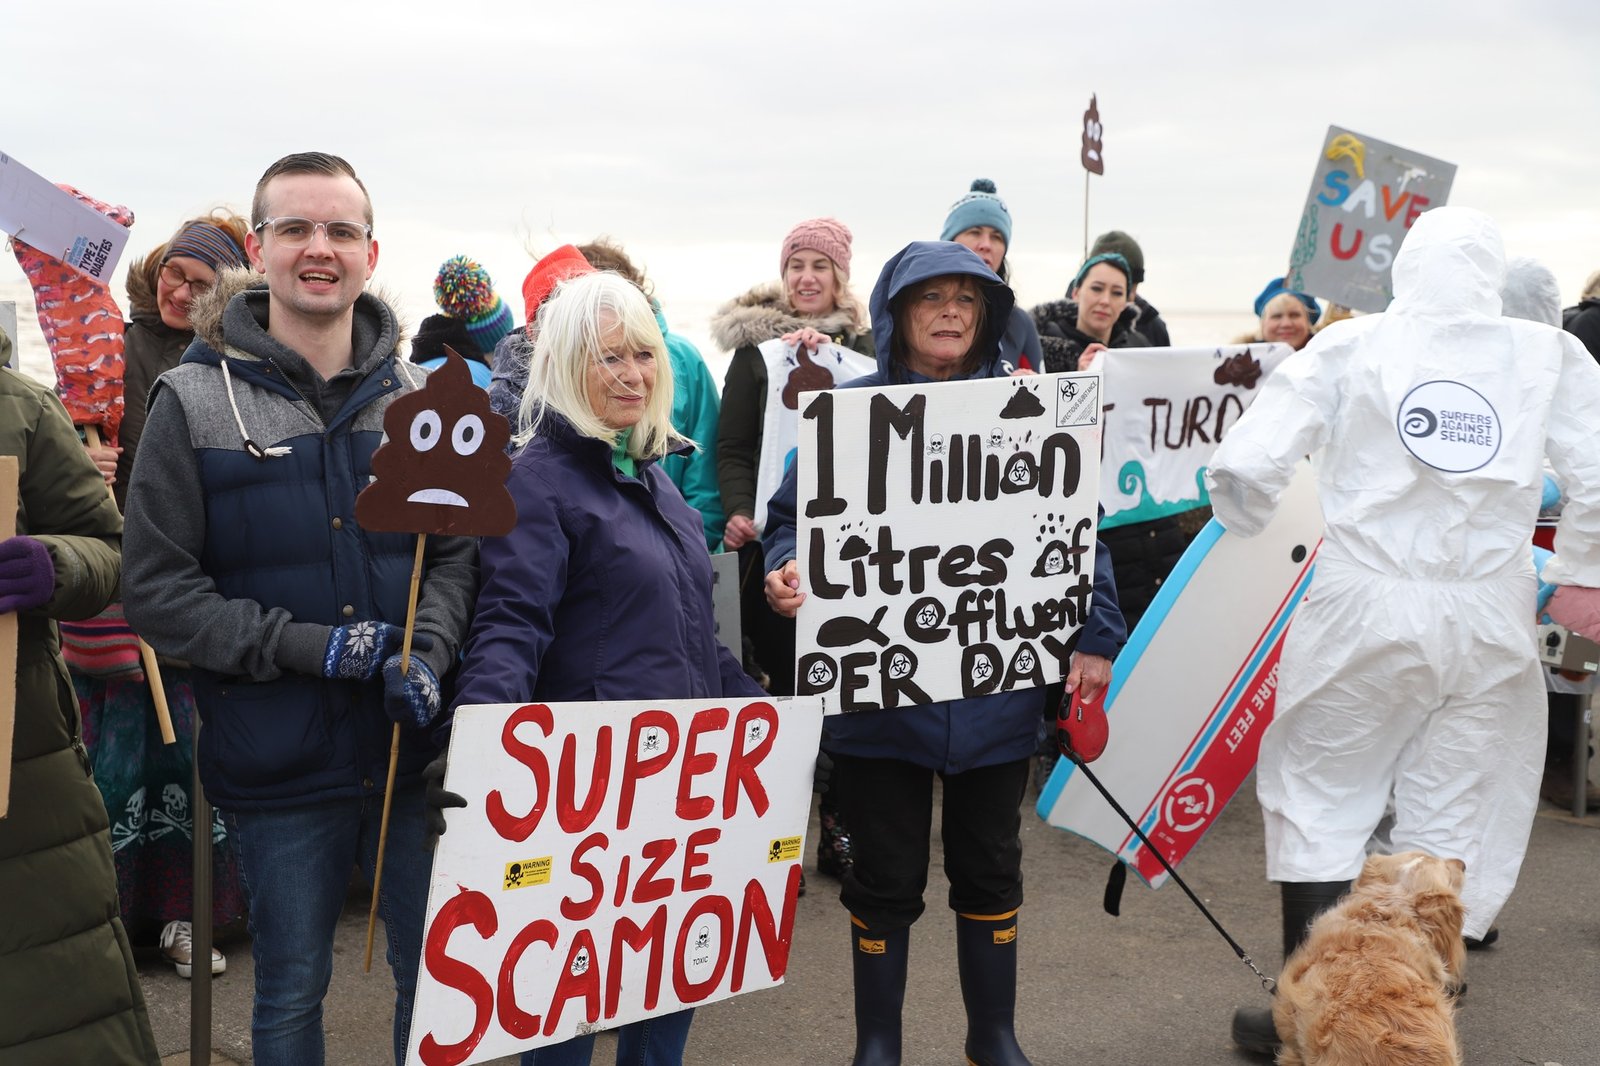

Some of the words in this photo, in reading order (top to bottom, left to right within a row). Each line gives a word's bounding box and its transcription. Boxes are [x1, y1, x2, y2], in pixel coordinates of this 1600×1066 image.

[1317, 170, 1430, 229] SAVE
[79, 248, 96, 270] TYPE
[89, 241, 99, 251] 2
[89, 239, 113, 277] DIABETES
[1330, 223, 1393, 272] US
[1060, 402, 1080, 425] INFECTIOUS
[1078, 381, 1097, 406] SUBSTANCE
[1440, 410, 1492, 425] SURFERS
[1440, 420, 1492, 435] AGAINST
[1440, 430, 1492, 447] SEWAGE
[803, 392, 848, 518] 1
[867, 393, 1081, 515] Million
[809, 526, 1014, 599] Litres
[904, 574, 1092, 647] effluent
[797, 644, 934, 712] PER
[961, 628, 1085, 698] DAY
[1251, 662, 1280, 712] BARE
[1225, 708, 1256, 753] FEET
[486, 702, 779, 842] SUPER
[523, 859, 550, 870] WARNING
[782, 837, 801, 846] WARNING
[560, 828, 721, 920] SIZE
[419, 864, 802, 1066] SCAMON
[693, 955, 709, 965] TOXIC
